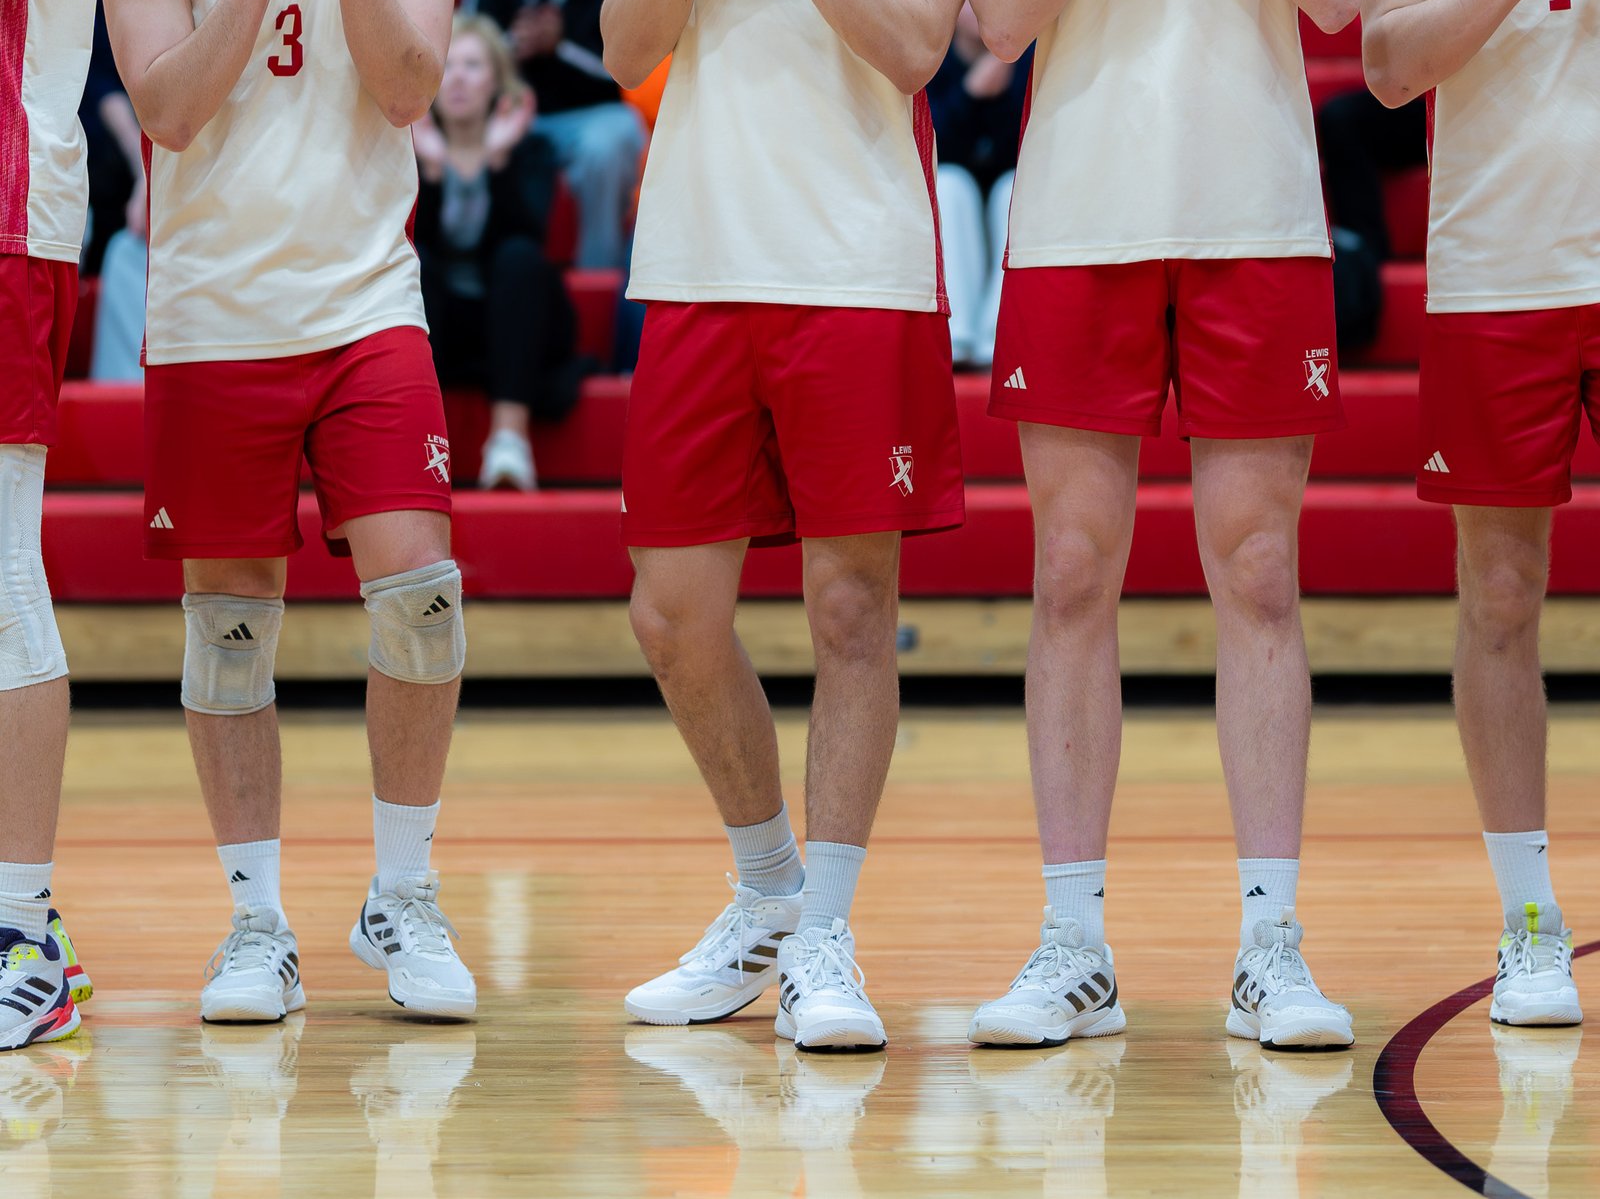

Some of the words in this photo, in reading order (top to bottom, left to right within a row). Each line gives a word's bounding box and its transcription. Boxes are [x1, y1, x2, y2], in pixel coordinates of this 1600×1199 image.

[267, 3, 304, 77] 3
[1305, 347, 1330, 359] LEWIS
[892, 445, 913, 455] LEWIS
